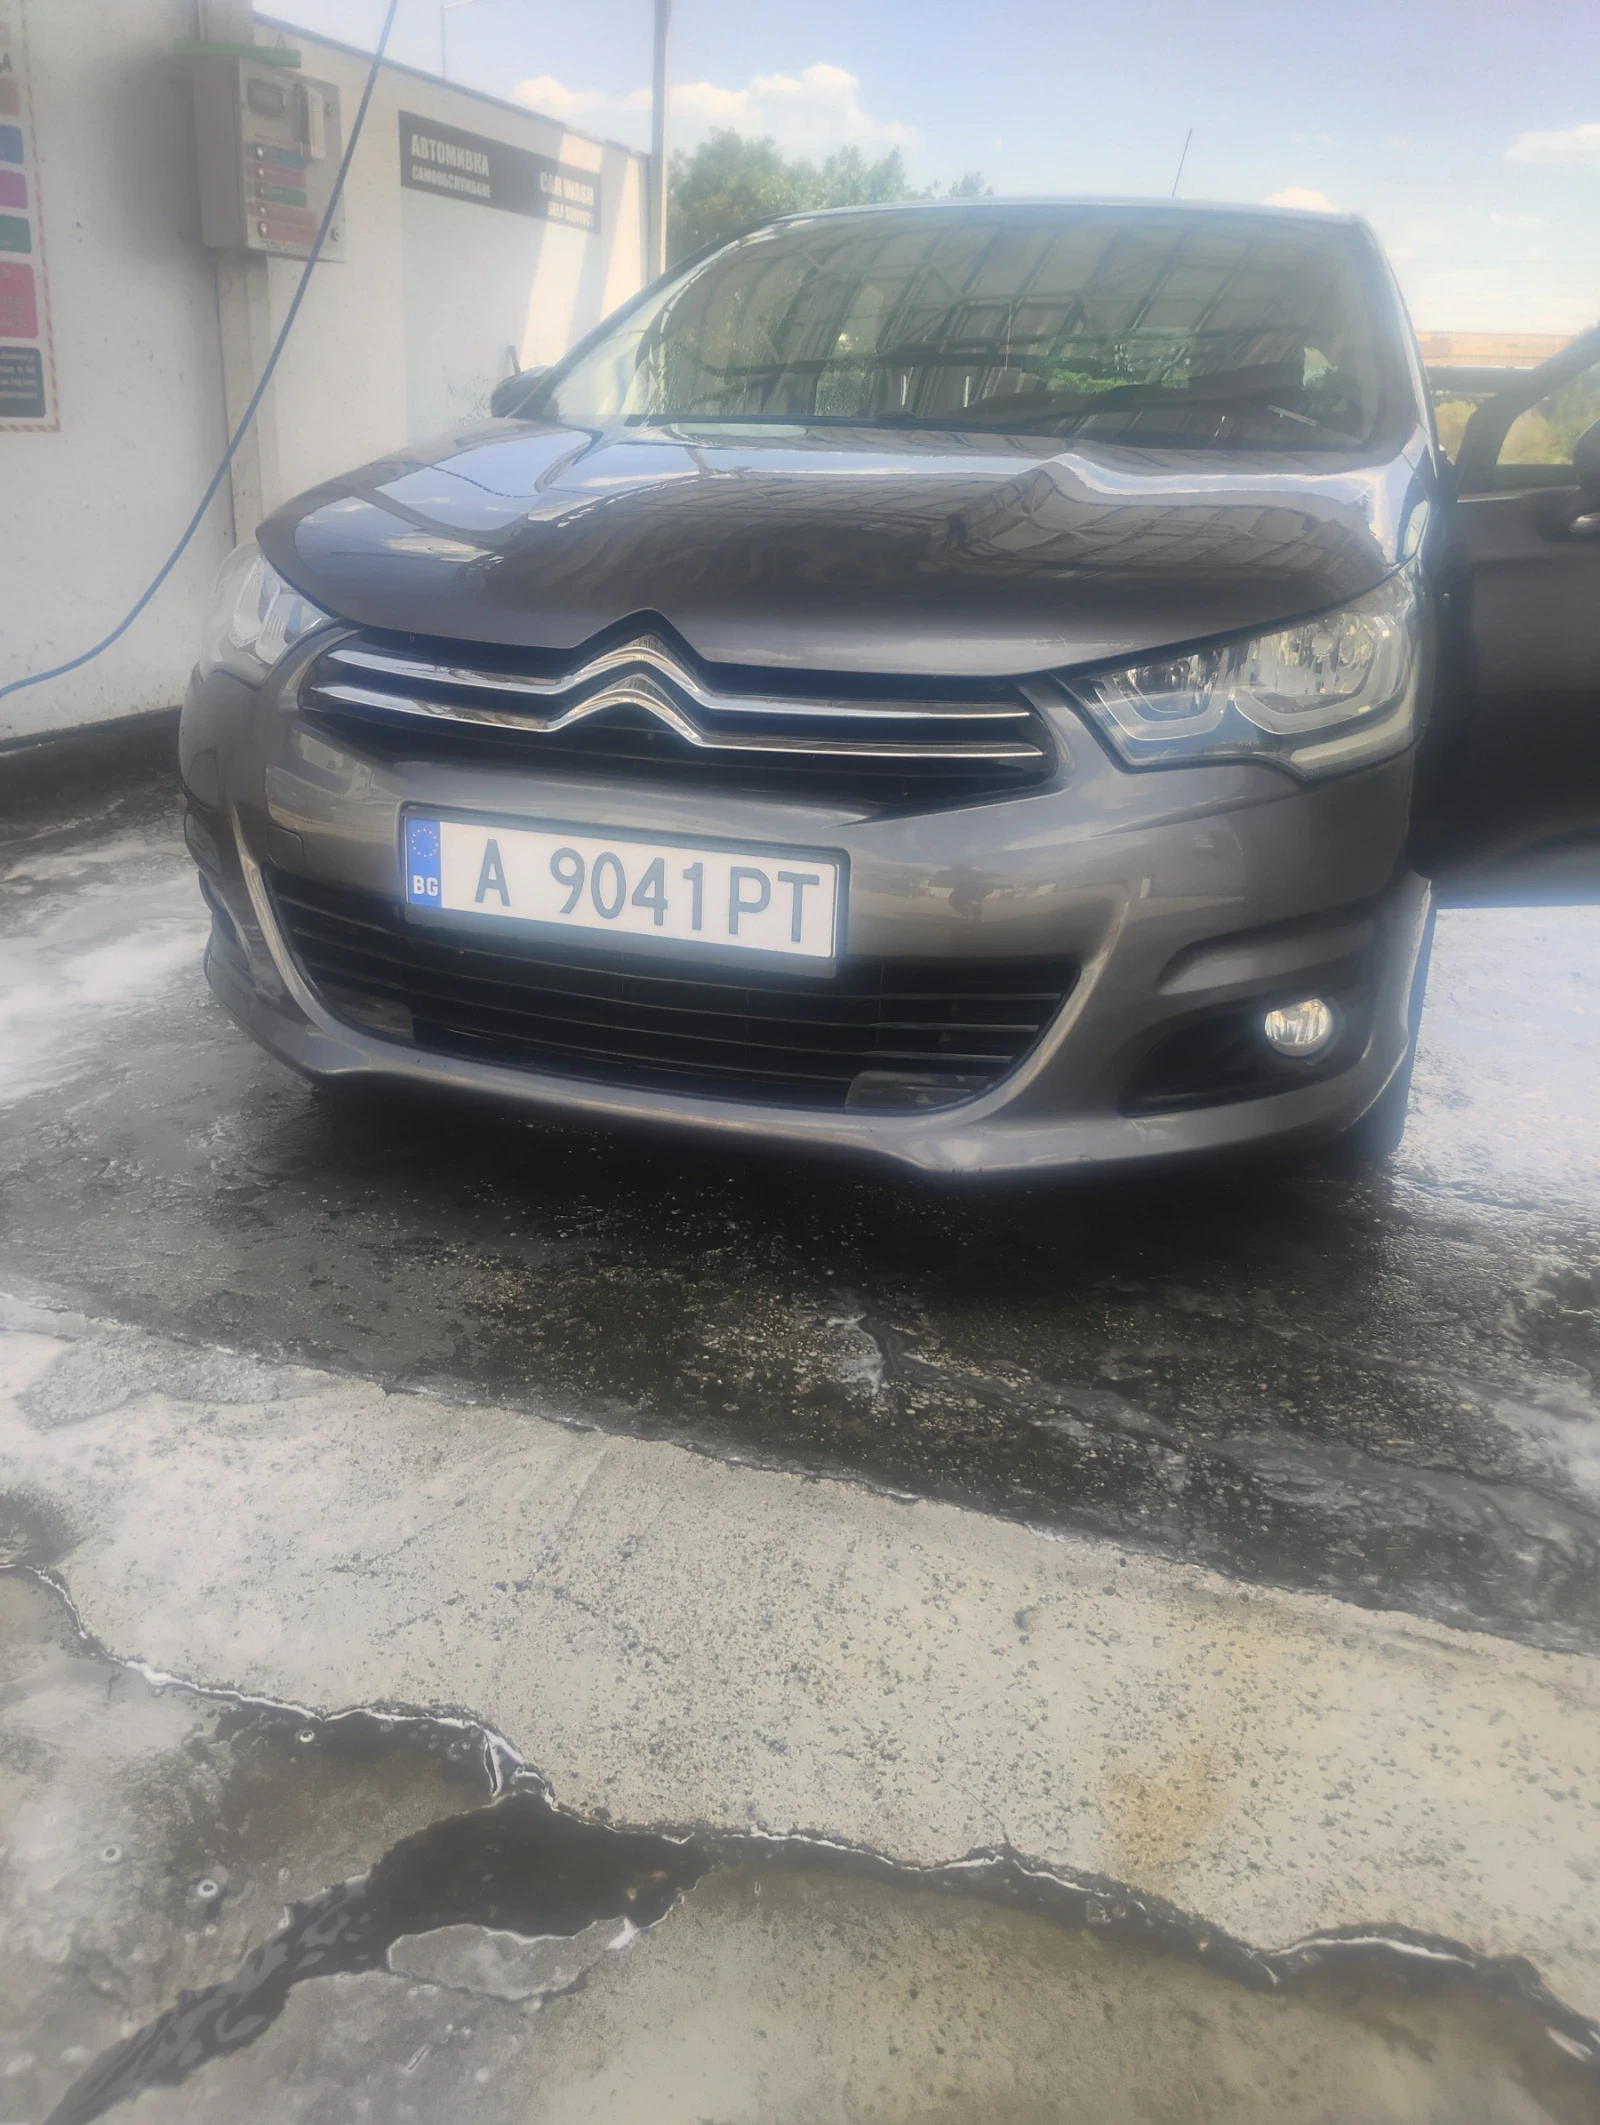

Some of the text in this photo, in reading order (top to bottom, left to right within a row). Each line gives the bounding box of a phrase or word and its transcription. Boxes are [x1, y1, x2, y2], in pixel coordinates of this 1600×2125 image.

[412, 134, 489, 178] АВТОМИВКА
[540, 172, 594, 207] CAR WASH
[413, 874, 439, 897] BG
[474, 838, 511, 907] A
